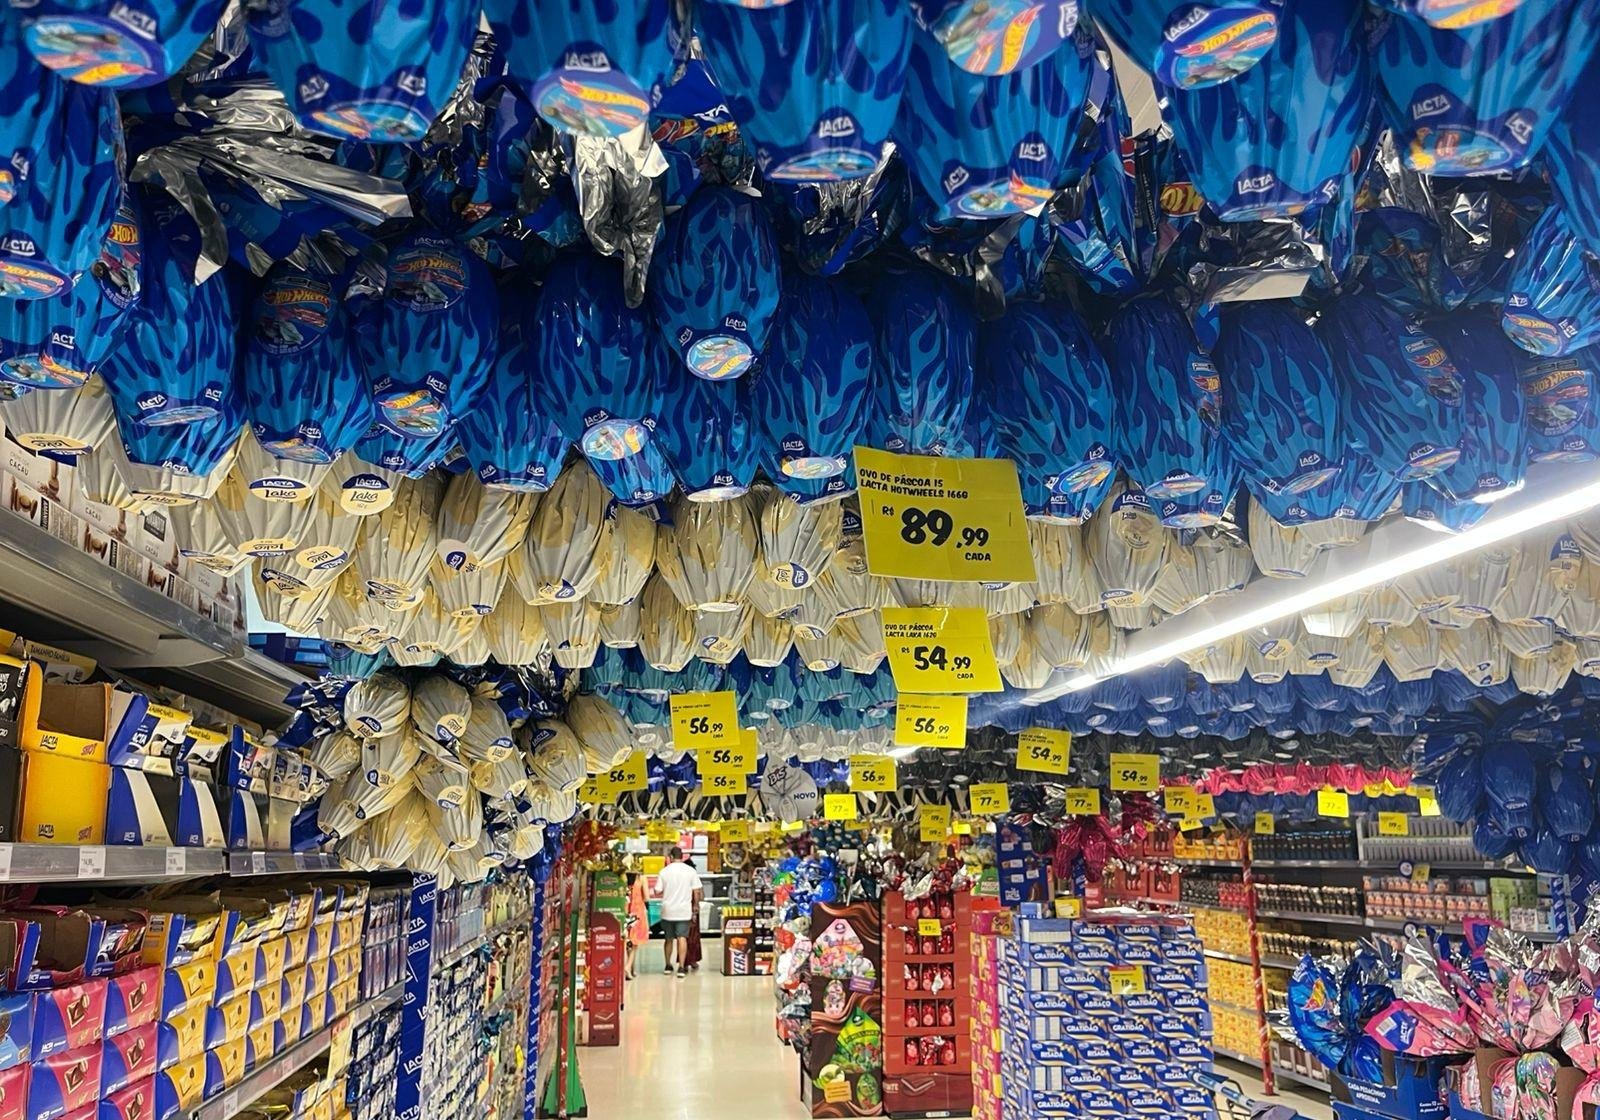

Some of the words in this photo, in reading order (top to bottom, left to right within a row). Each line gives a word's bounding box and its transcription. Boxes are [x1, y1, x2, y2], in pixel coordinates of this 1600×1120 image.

[110, 3, 156, 40] LACTA
[1164, 6, 1209, 42] LACTA
[565, 52, 609, 72] LACTA
[1412, 94, 1450, 121] LACTA
[1019, 142, 1047, 161] LACTA
[1238, 174, 1275, 194] LACTA
[138, 394, 167, 411] LACTA
[782, 441, 805, 452] LACTA
[9, 458, 28, 477] CACAU
[357, 478, 382, 487] LACTA
[714, 473, 733, 486] LACTA
[860, 468, 877, 479] OVO
[880, 472, 891, 482] DE
[894, 474, 931, 487] PÁSCOA
[262, 480, 295, 488] LACTA
[860, 479, 888, 492] LACTA
[890, 485, 944, 498] HOTWHEELS
[265, 488, 298, 499] Laka
[350, 491, 378, 503] Laka
[1122, 493, 1148, 505] LACT
[85, 507, 101, 522] CACAU
[882, 506, 894, 516] R$
[965, 553, 991, 561] CADA
[909, 623, 934, 631] PÁSCOA
[40, 734, 58, 750] LACTA
[793, 792, 816, 800] NOVO
[38, 824, 55, 838] LACTA
[1034, 950, 1065, 959] GRATIDÃO
[1077, 950, 1109, 959] GRATIDÃO
[1064, 973, 1095, 983] GRATIDÃO
[1034, 998, 1066, 1008] GRATIDÃO
[1066, 1022, 1098, 1032] GRATIDÃO
[1112, 1021, 1144, 1031] GRATIDÃO
[1069, 1072, 1101, 1083] GRATIDÃO
[1037, 1099, 1070, 1108] GRATIDÃO
